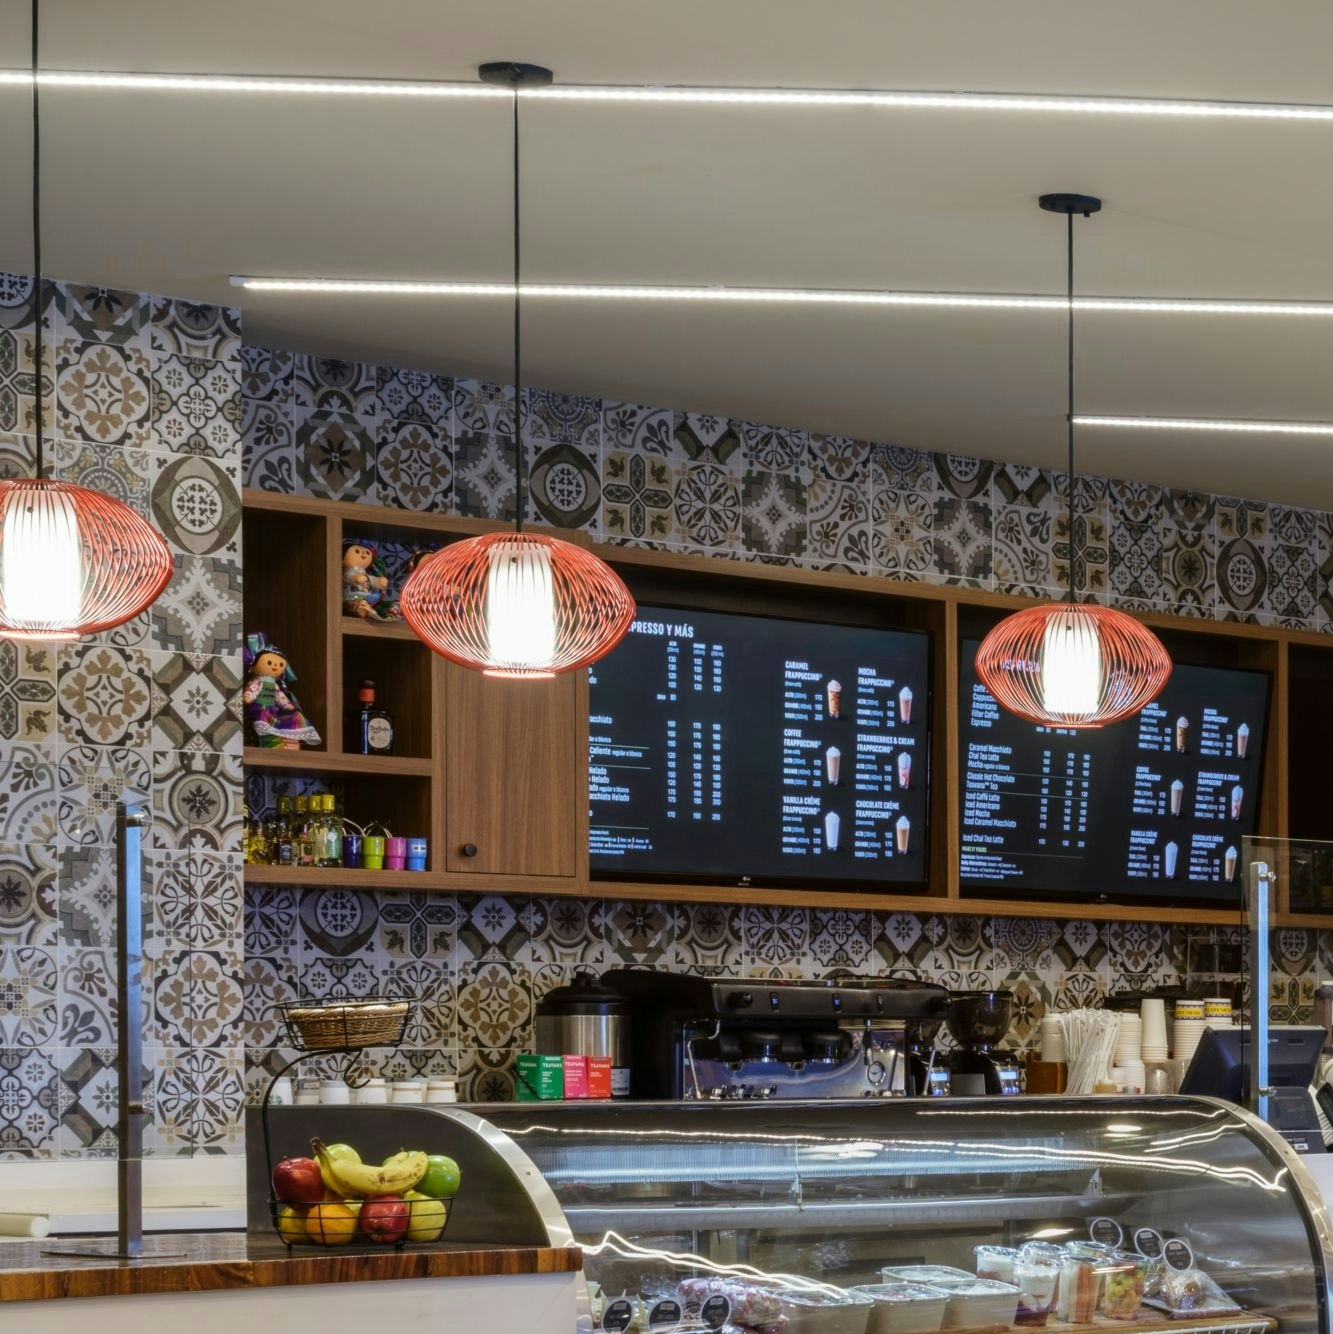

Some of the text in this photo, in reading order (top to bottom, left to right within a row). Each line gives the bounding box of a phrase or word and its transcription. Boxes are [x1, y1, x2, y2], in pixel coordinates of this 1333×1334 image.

[628, 621, 694, 638] PRESSO Y MÁS
[784, 728, 802, 737] COFFEE
